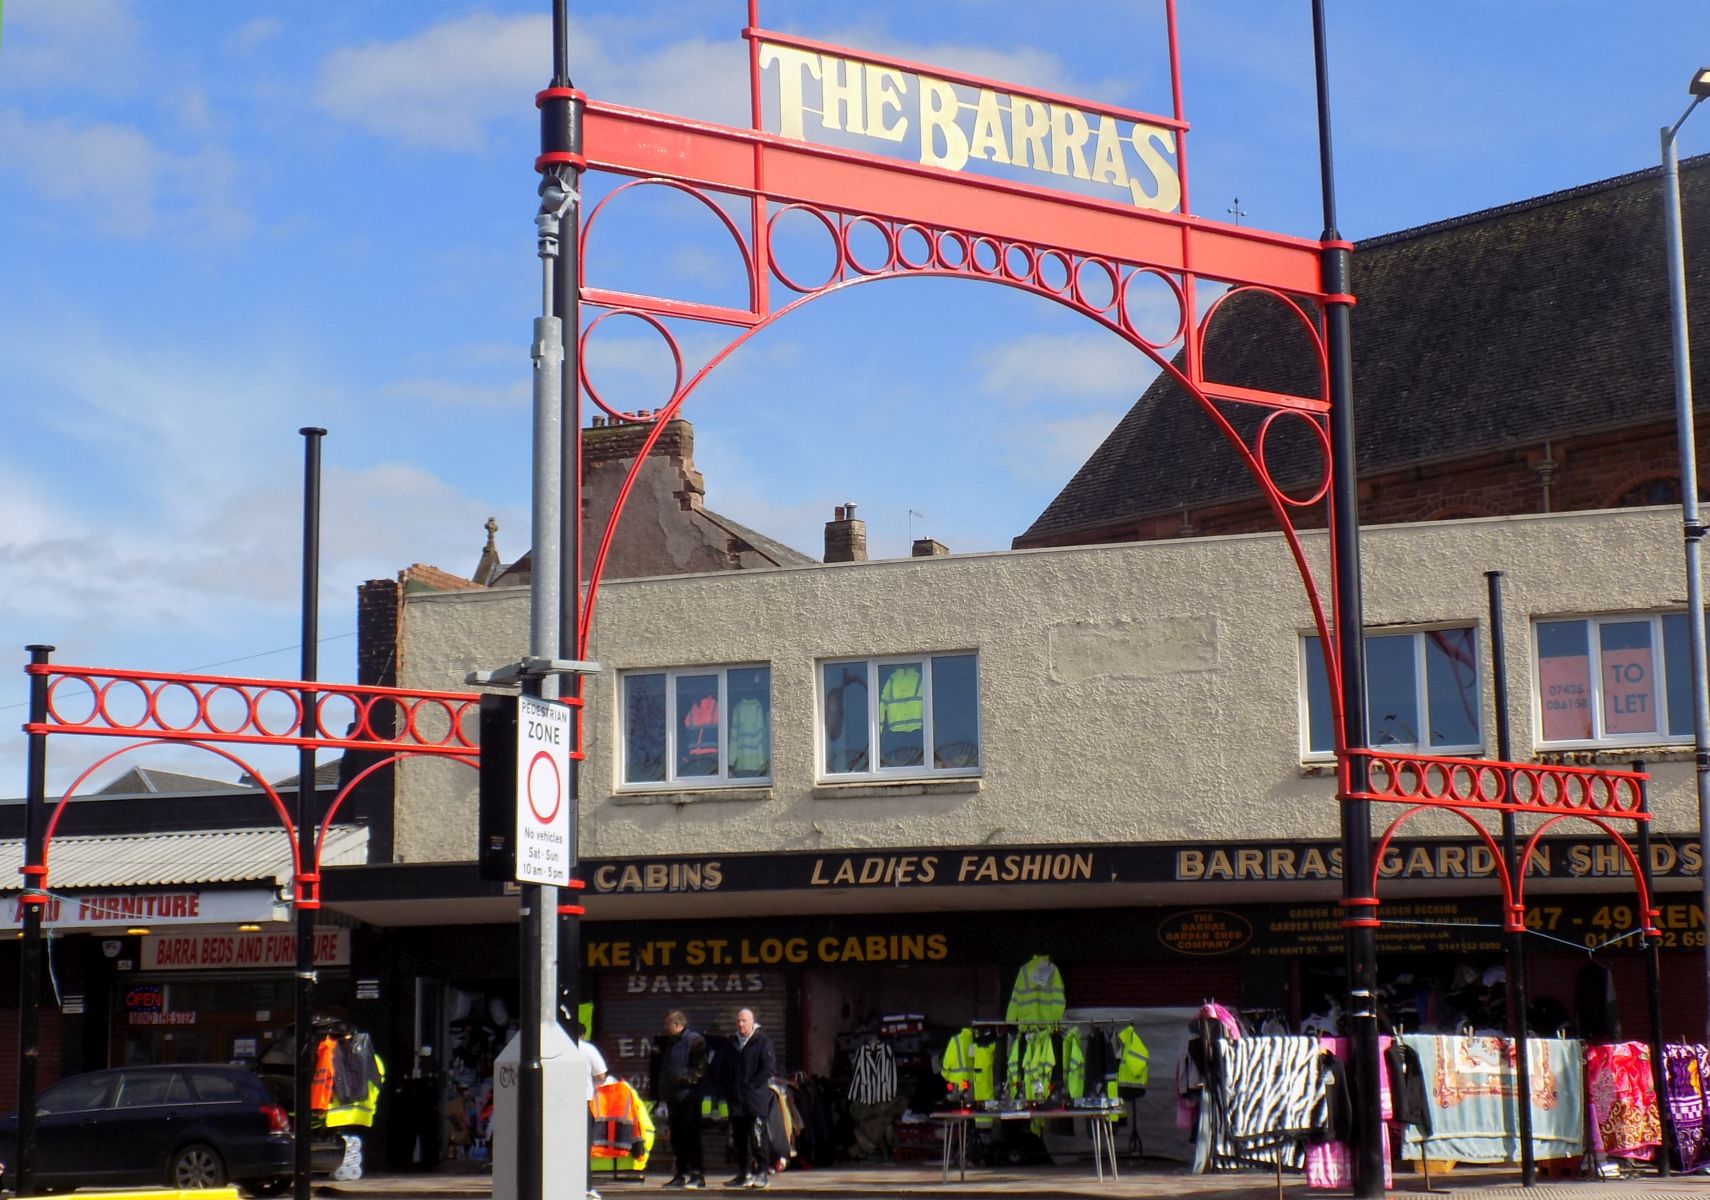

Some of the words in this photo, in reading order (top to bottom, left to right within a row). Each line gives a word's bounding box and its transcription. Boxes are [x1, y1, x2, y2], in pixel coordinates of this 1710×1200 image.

[758, 41, 909, 145] THE
[917, 73, 1182, 213] BARRAS
[1611, 662, 1645, 684] TO
[521, 700, 568, 723] PEDESTRIAN
[1612, 693, 1649, 715] LET
[527, 720, 561, 745] ZONE
[524, 826, 534, 840] No
[536, 829, 563, 845] vehicles
[528, 846, 541, 860] Sat
[545, 848, 559, 863] Sun
[1175, 847, 1343, 881] BARRAS
[1376, 844, 1551, 879] GARDN
[592, 861, 725, 894] CABINS
[810, 855, 939, 887] LADIES
[957, 851, 1095, 885] FASHION
[78, 894, 200, 921] FURNITURE
[1192, 913, 1216, 923] THE
[1289, 907, 1329, 919] GARDEN
[1524, 906, 1563, 931] 47
[1592, 905, 1634, 930] 49
[1165, 931, 1211, 941] GARDEN
[1213, 930, 1243, 941] SHED
[1180, 921, 1227, 932] BARRAS
[1270, 920, 1309, 932] GARDEN
[156, 938, 198, 966] BARRA
[200, 937, 235, 964] BEDS
[235, 936, 263, 963] AND
[265, 934, 338, 962] FURNURE
[685, 938, 733, 966] ST.
[741, 937, 809, 965] LOG
[817, 934, 949, 963] CABINS
[1176, 939, 1231, 950] COMPANY
[627, 972, 764, 994] BARRAS
[126, 991, 161, 1007] OPEN
